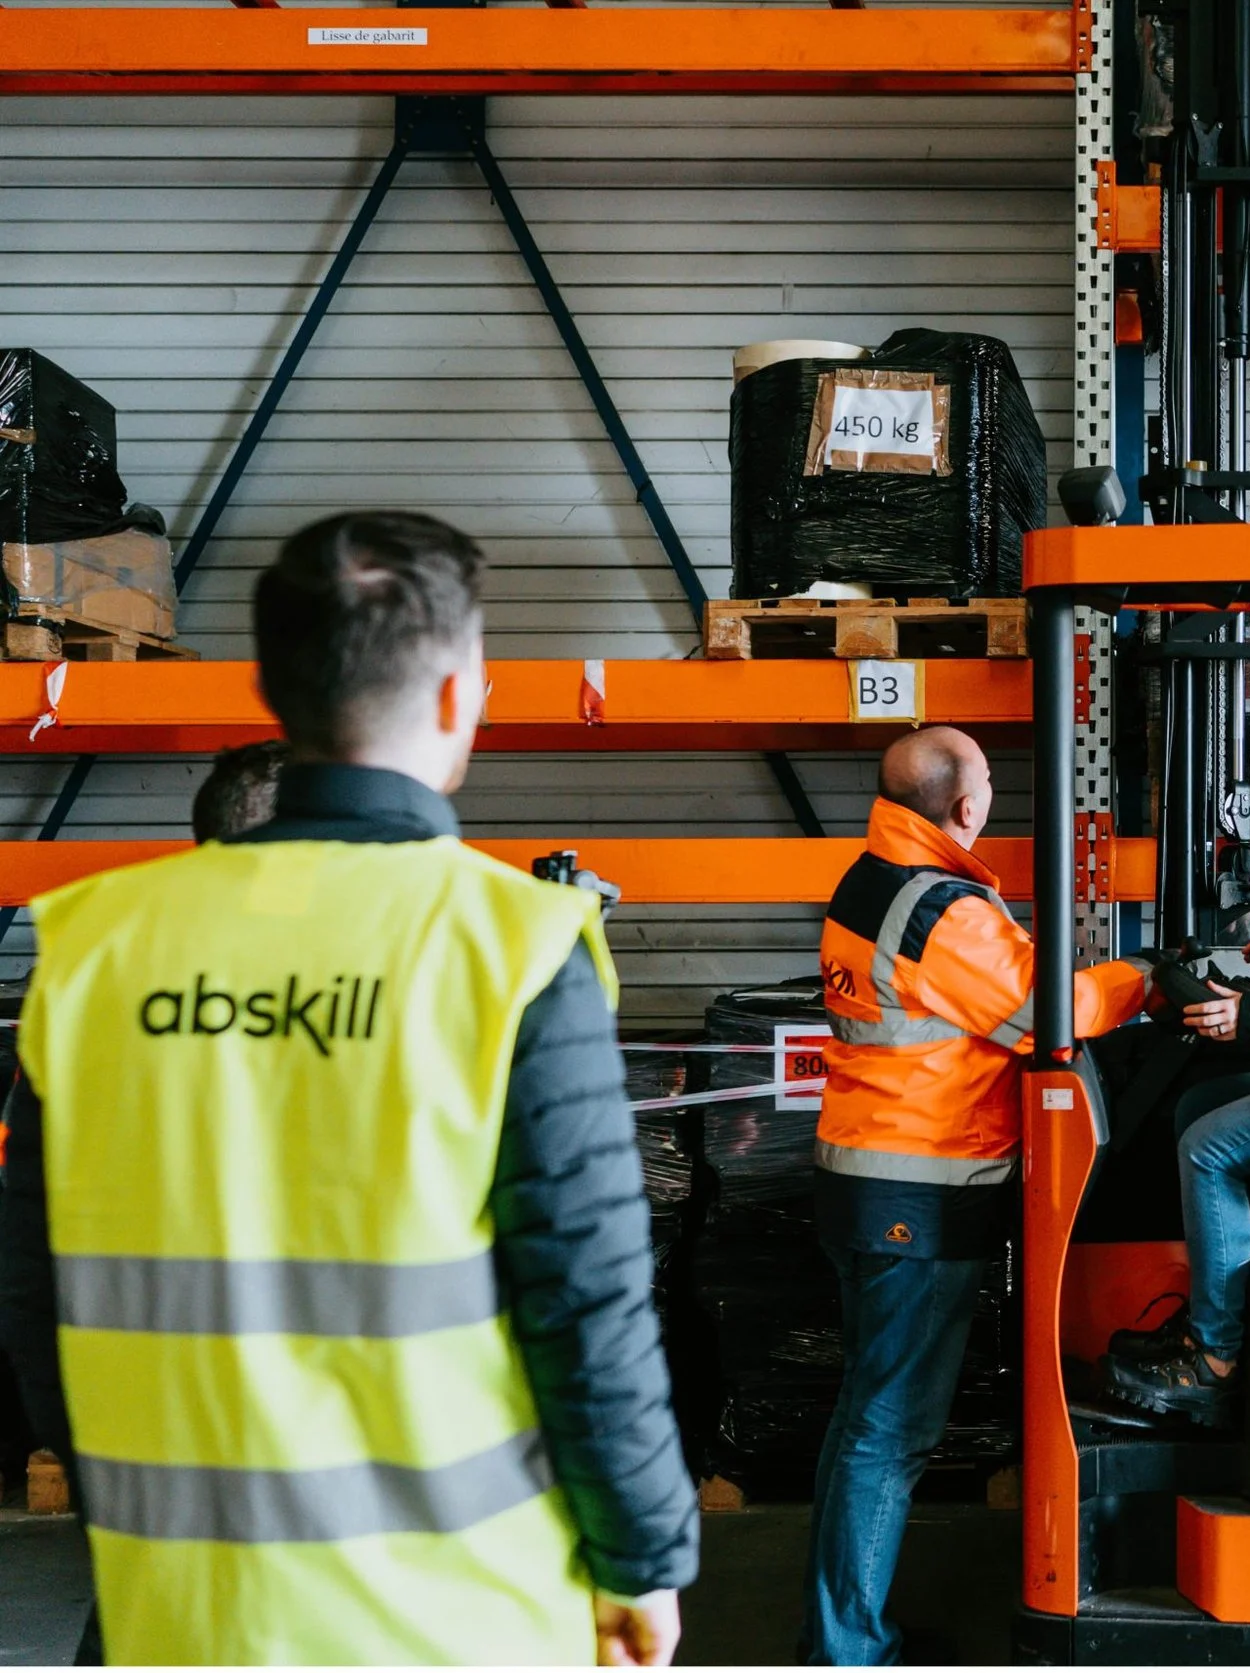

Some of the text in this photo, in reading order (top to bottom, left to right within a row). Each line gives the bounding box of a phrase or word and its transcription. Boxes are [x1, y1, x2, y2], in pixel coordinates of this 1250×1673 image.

[322, 30, 415, 43] Lisse de gabarit
[835, 416, 919, 443] 450 kg
[860, 676, 899, 705] B3
[140, 973, 382, 1057] abskill
